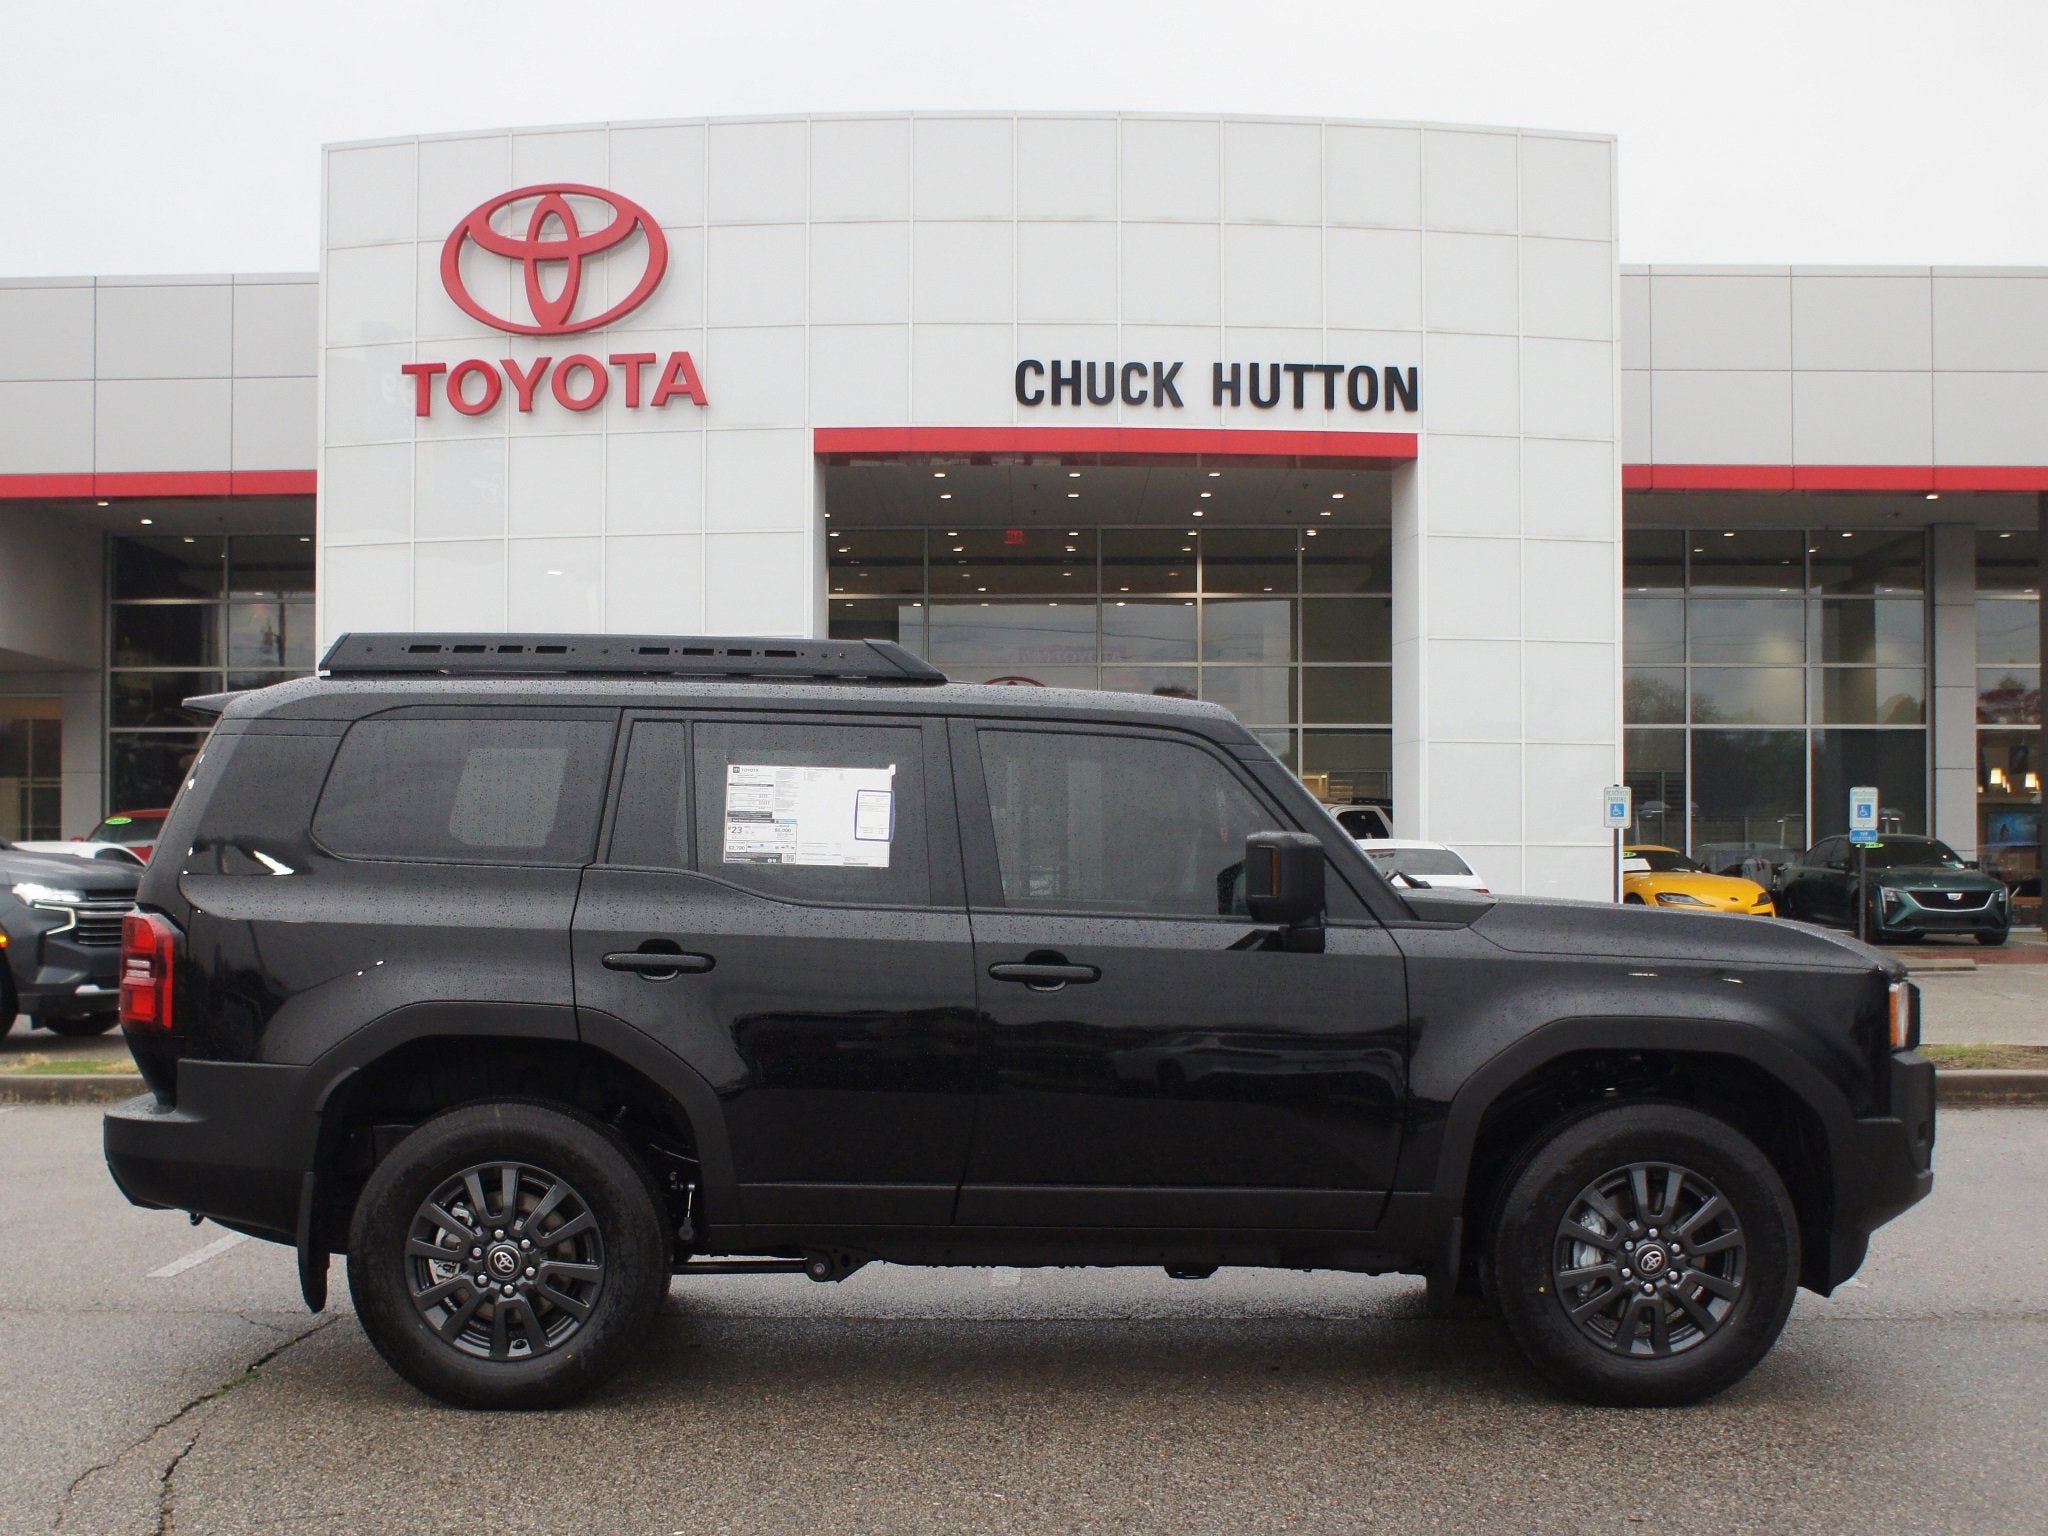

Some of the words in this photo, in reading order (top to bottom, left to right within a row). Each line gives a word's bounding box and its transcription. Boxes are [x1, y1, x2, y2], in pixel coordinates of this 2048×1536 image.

[401, 351, 709, 417] TOYOTA
[1015, 359, 1184, 408] CHUCK
[1213, 362, 1418, 412] HUTTON
[731, 826, 743, 834] 23
